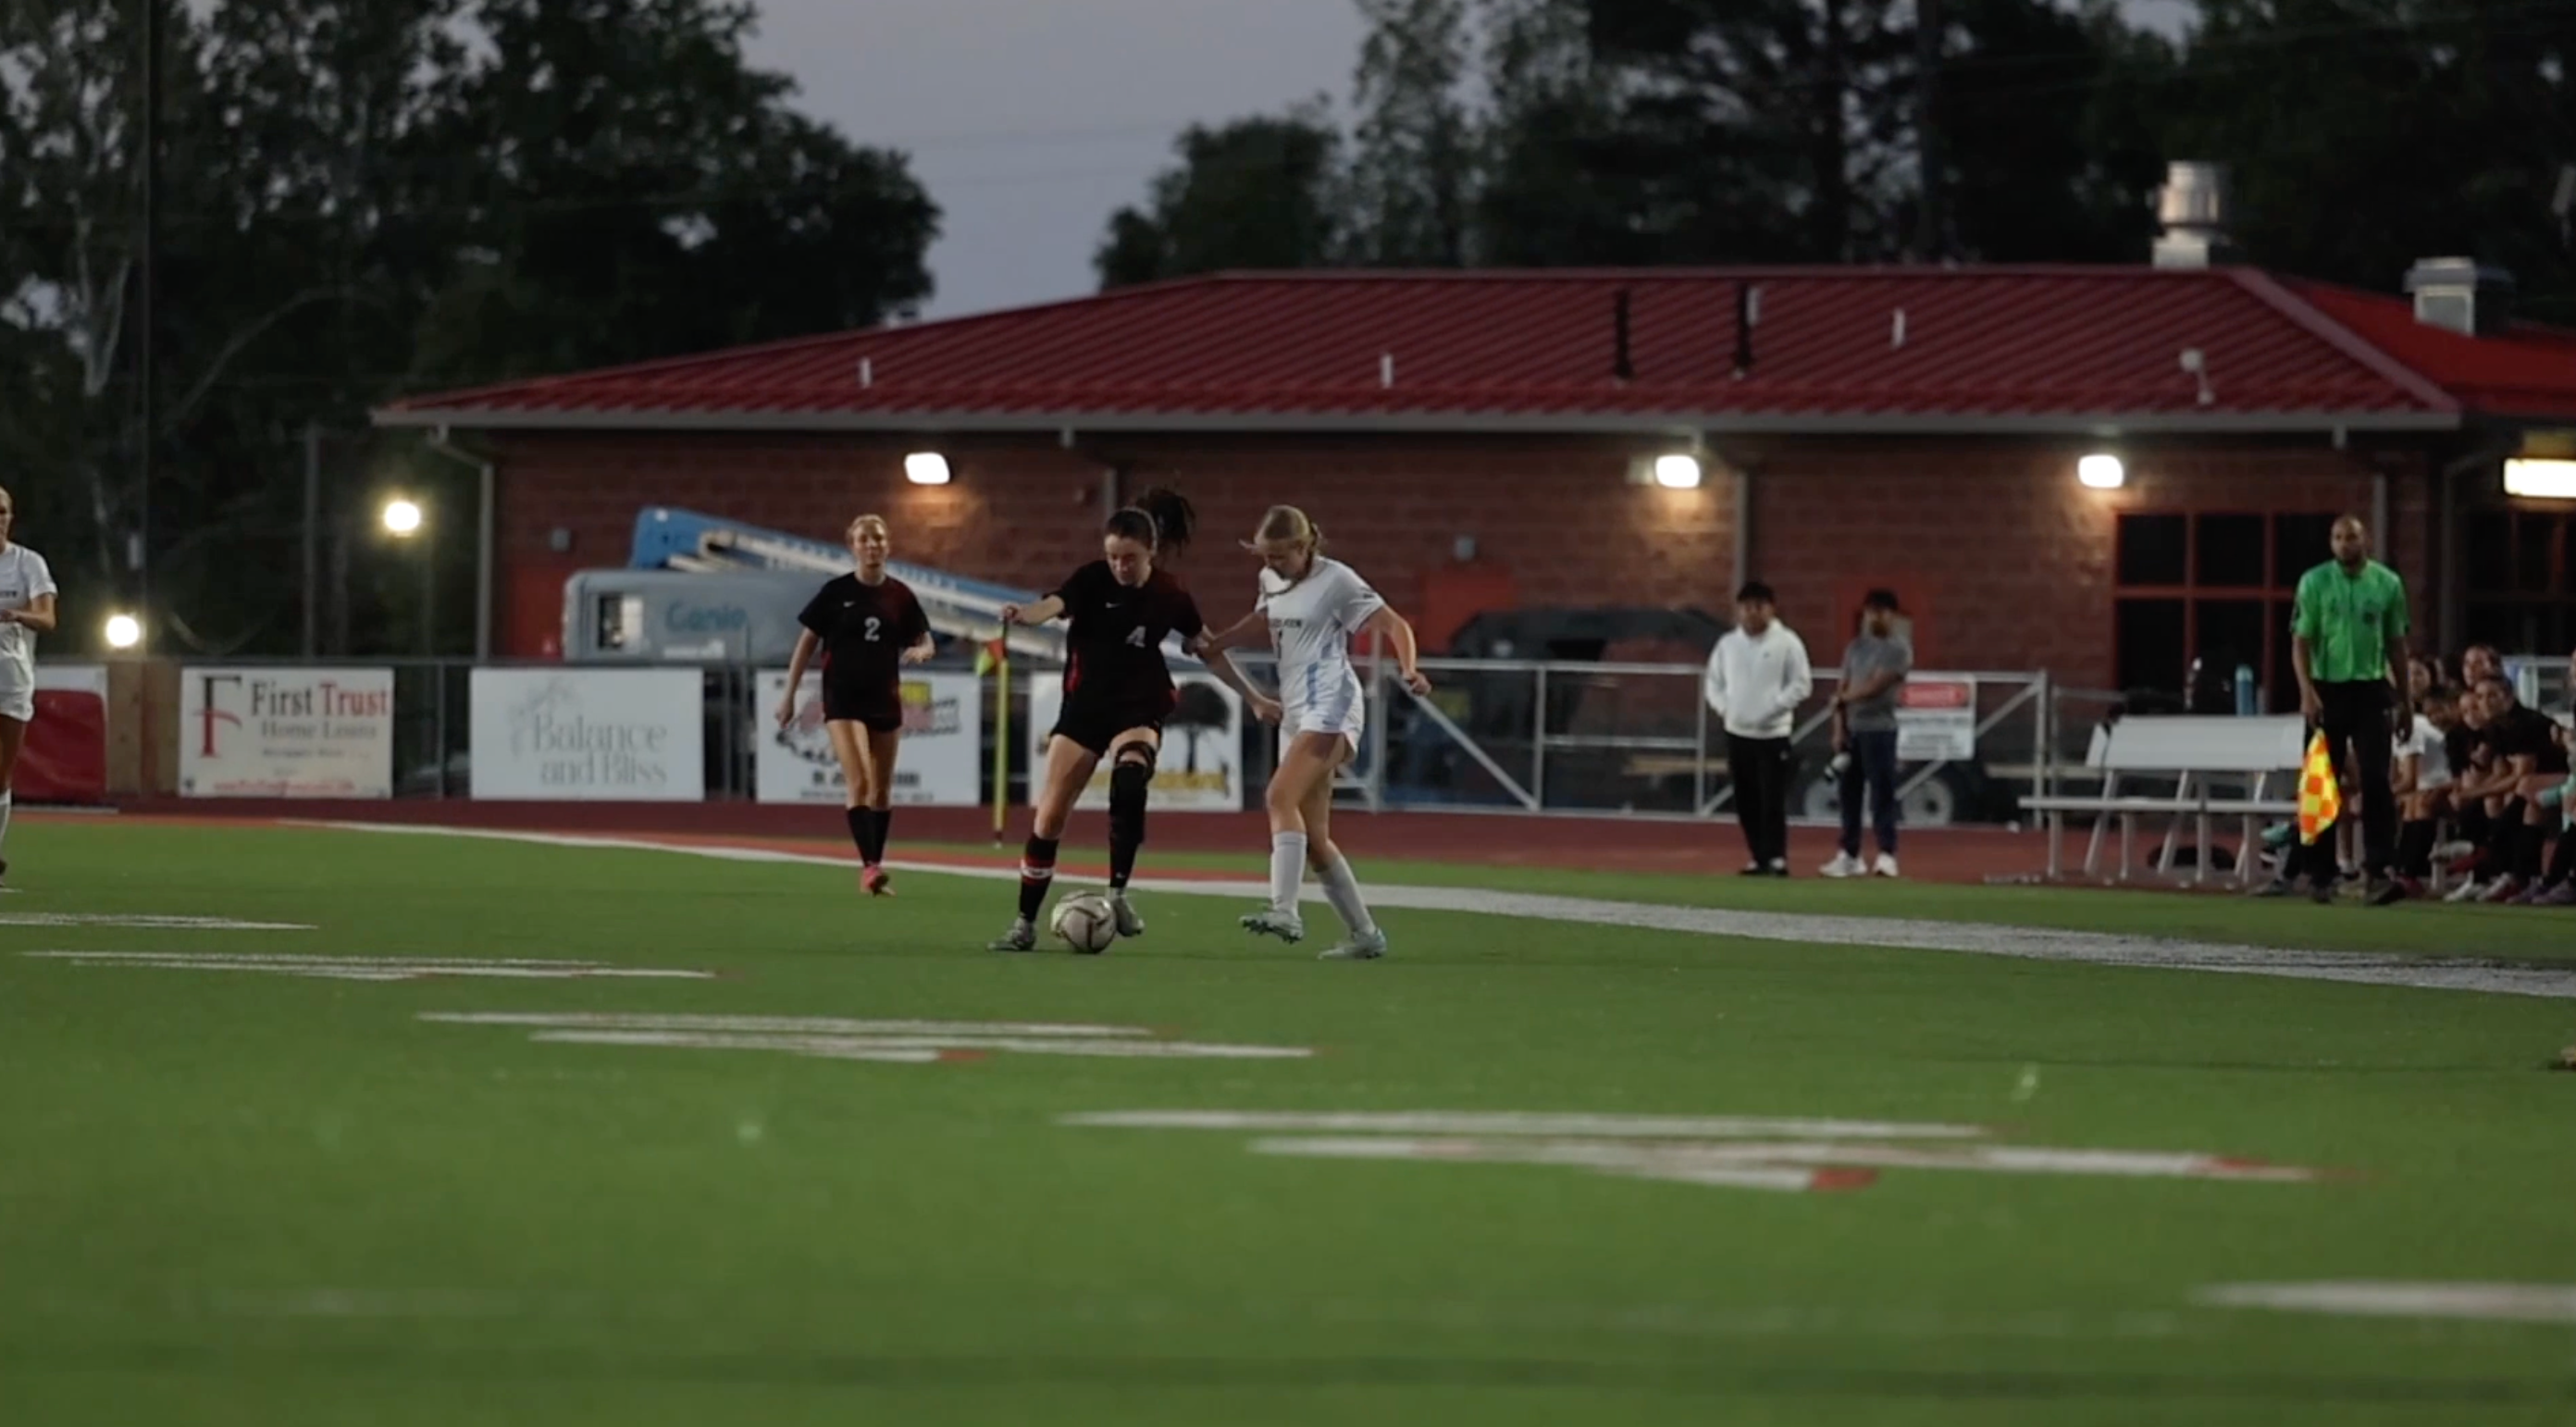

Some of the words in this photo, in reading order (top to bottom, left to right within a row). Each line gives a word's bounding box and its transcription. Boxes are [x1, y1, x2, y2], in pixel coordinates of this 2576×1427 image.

[864, 616, 881, 641] 2
[1126, 625, 1146, 648] 4
[252, 678, 313, 717] First
[319, 680, 388, 718] Trust
[262, 720, 315, 738] Home
[533, 714, 667, 754] Balance
[541, 751, 595, 785] and
[604, 751, 667, 785] Bliss
